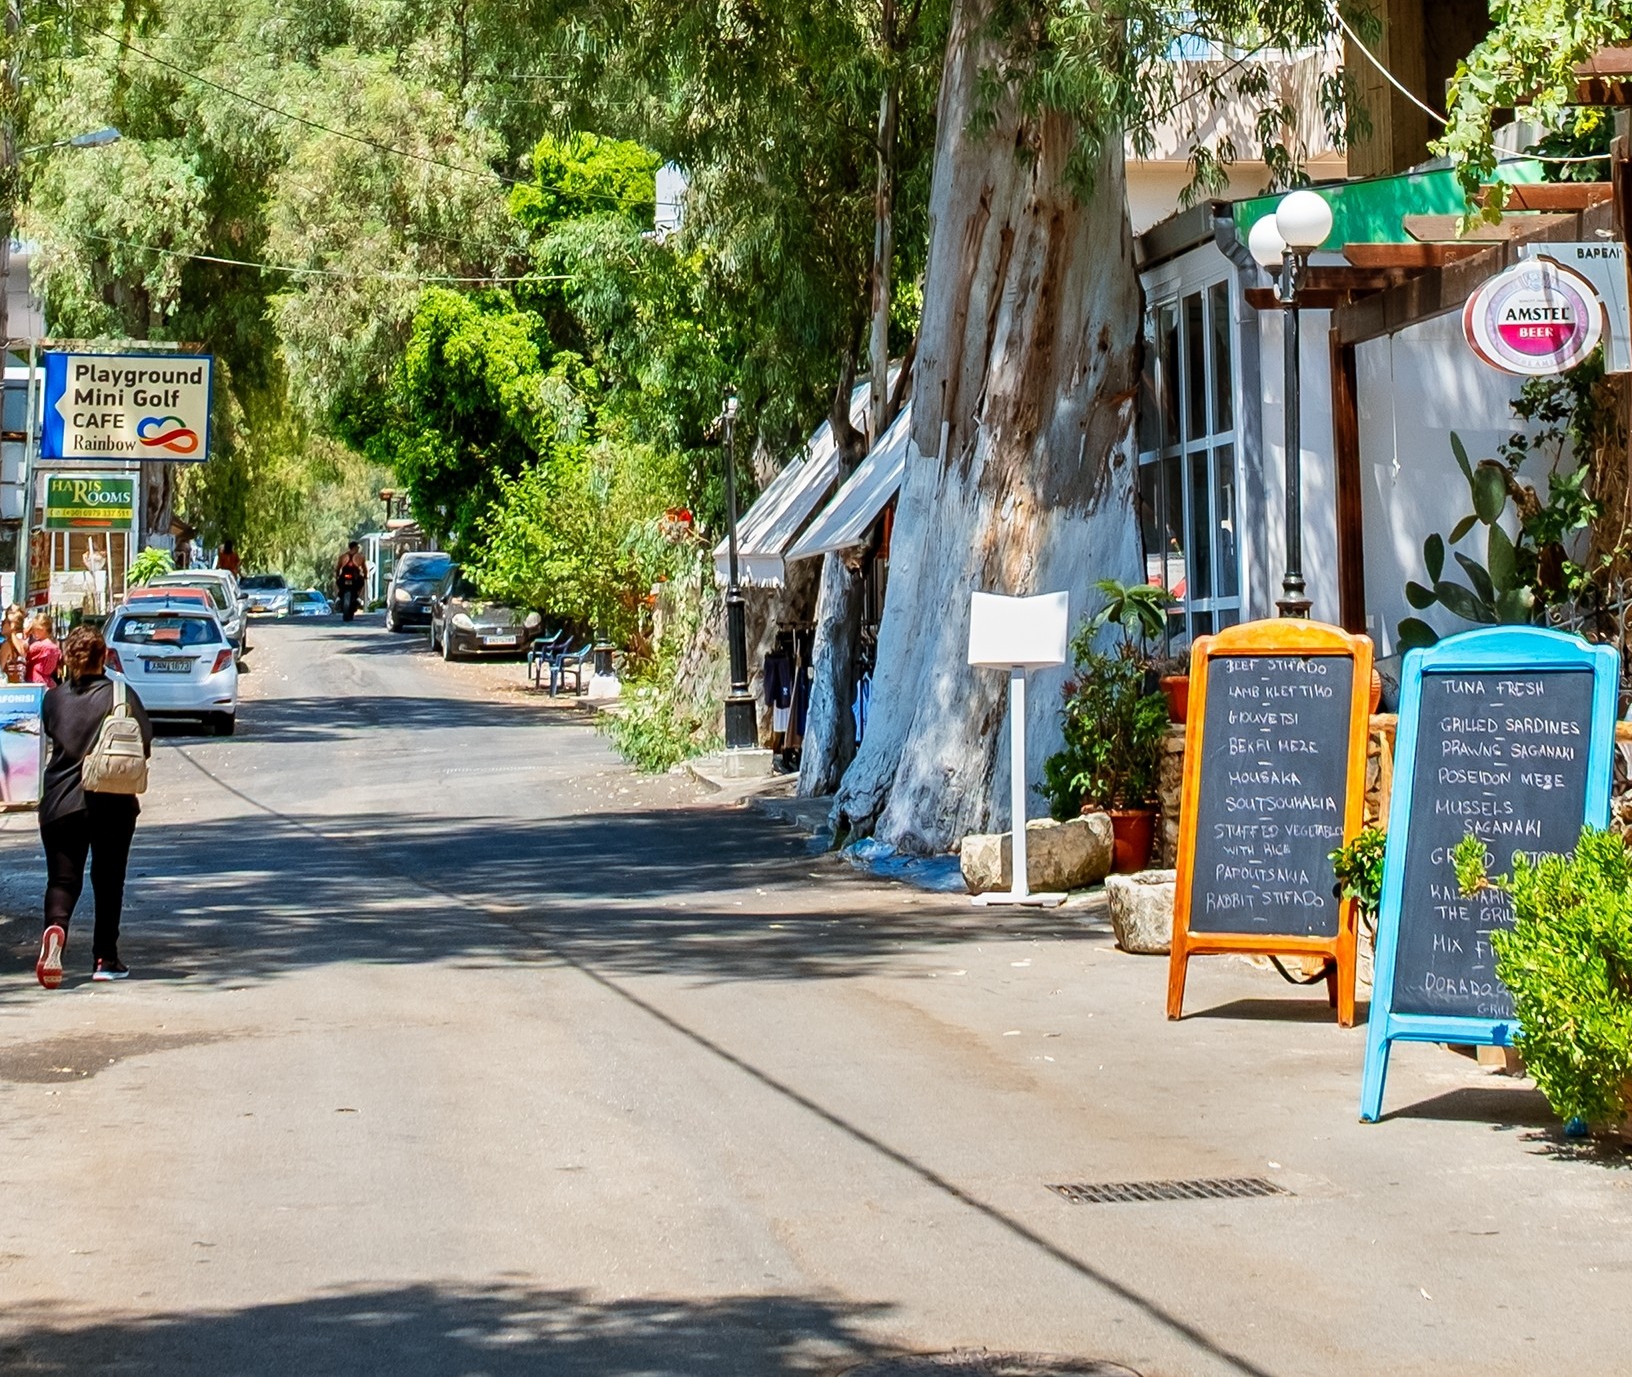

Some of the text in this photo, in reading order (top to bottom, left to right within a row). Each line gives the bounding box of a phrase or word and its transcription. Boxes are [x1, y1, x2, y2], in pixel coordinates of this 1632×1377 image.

[1506, 308, 1570, 321] AMSTEL
[1519, 327, 1554, 338] BEER
[75, 364, 203, 387] Playground
[74, 388, 180, 407] Mini Golf
[73, 413, 124, 429] CAFE
[73, 434, 136, 452] Rainbow
[1228, 685, 1260, 699] LAMB
[1441, 679, 1545, 697] TUNA FRESH
[1440, 717, 1580, 735] GRILLED SARDINES
[1510, 743, 1575, 761] SAGANAKI
[1438, 767, 1511, 786] POSEIDON
[1435, 799, 1514, 817] MUSSELS
[1214, 823, 1280, 840] STUFFED
[1463, 819, 1541, 838] SAGANAKI
[1223, 843, 1291, 857] WITH RICE
[1206, 890, 1324, 913] RABBIT STIFADO
[1434, 905, 1470, 921] THE
[1433, 934, 1464, 954] MIX
[1425, 972, 1492, 996] DORADO
